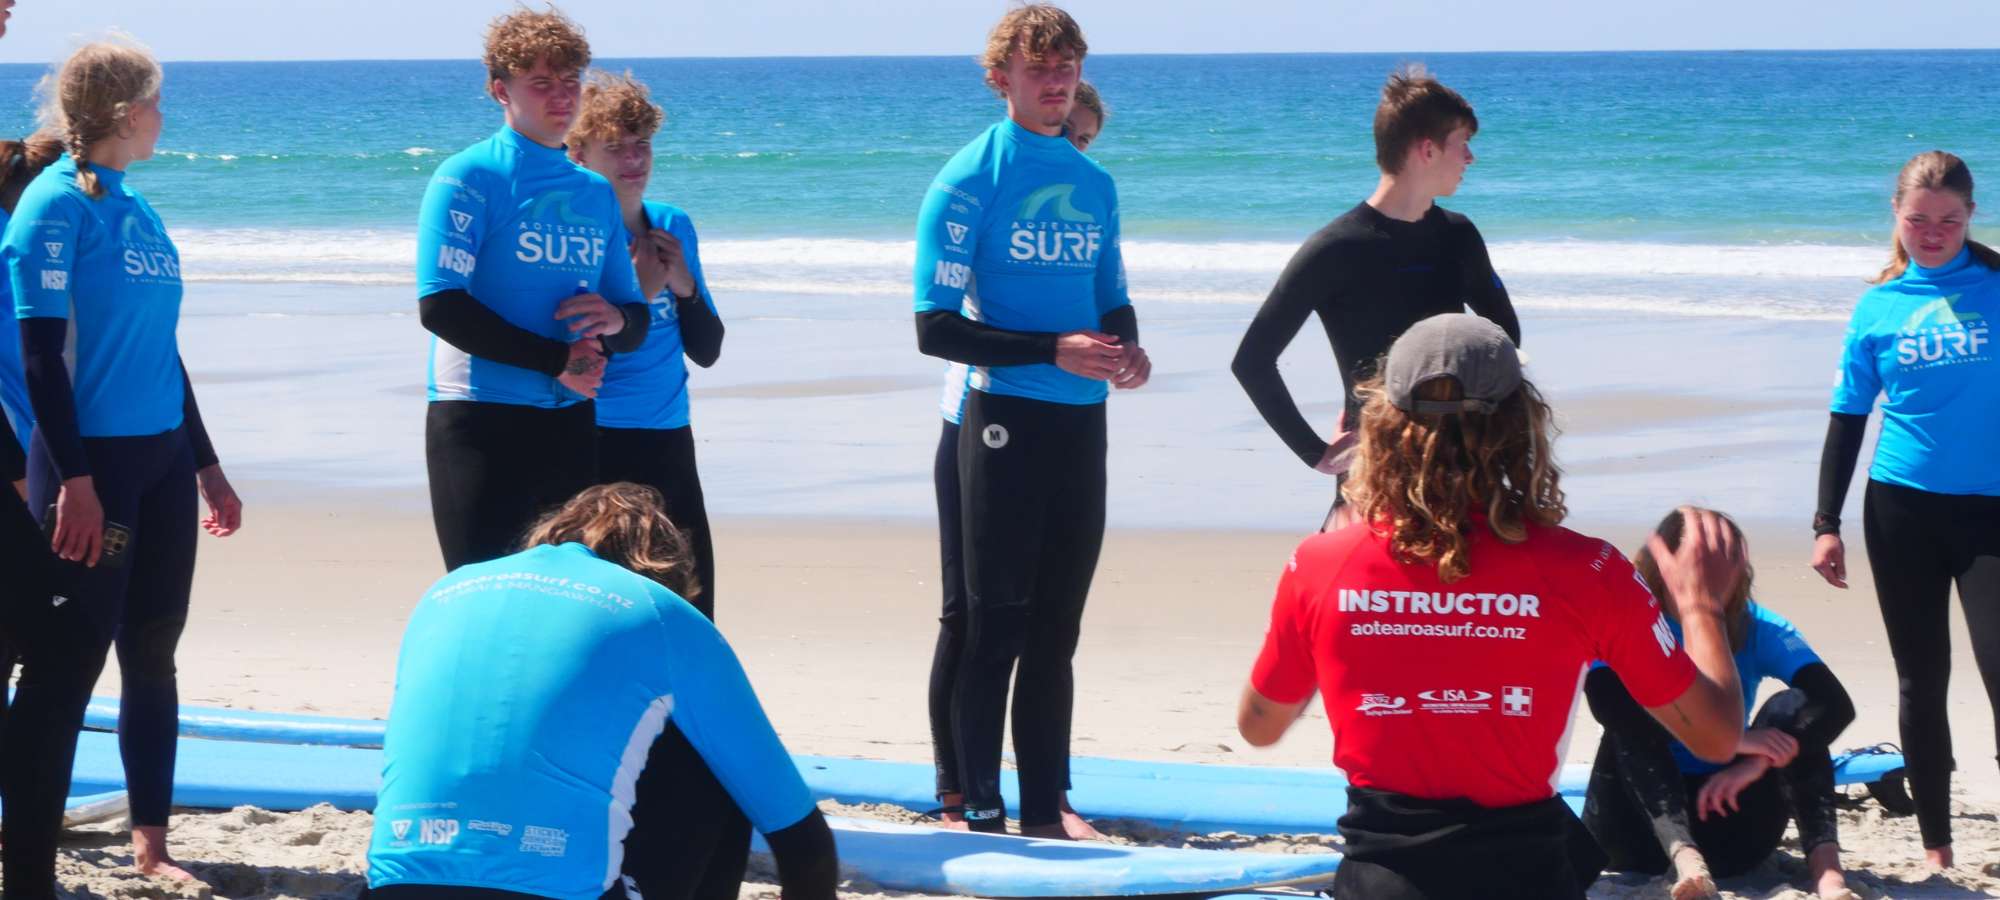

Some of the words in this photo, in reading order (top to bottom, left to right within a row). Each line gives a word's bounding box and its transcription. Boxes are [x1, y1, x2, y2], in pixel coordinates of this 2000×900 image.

[516, 232, 605, 266] SURF
[1009, 229, 1100, 262] SURF
[438, 245, 476, 277] NSP
[934, 260, 971, 290] NSP
[1897, 327, 1989, 365] SURF
[989, 430, 1001, 441] M
[1338, 588, 1540, 617] INSTRUCTOR
[1351, 621, 1526, 640] aotearoasurf.co.nz
[1443, 689, 1467, 702] ISA
[419, 819, 460, 844] NSP
